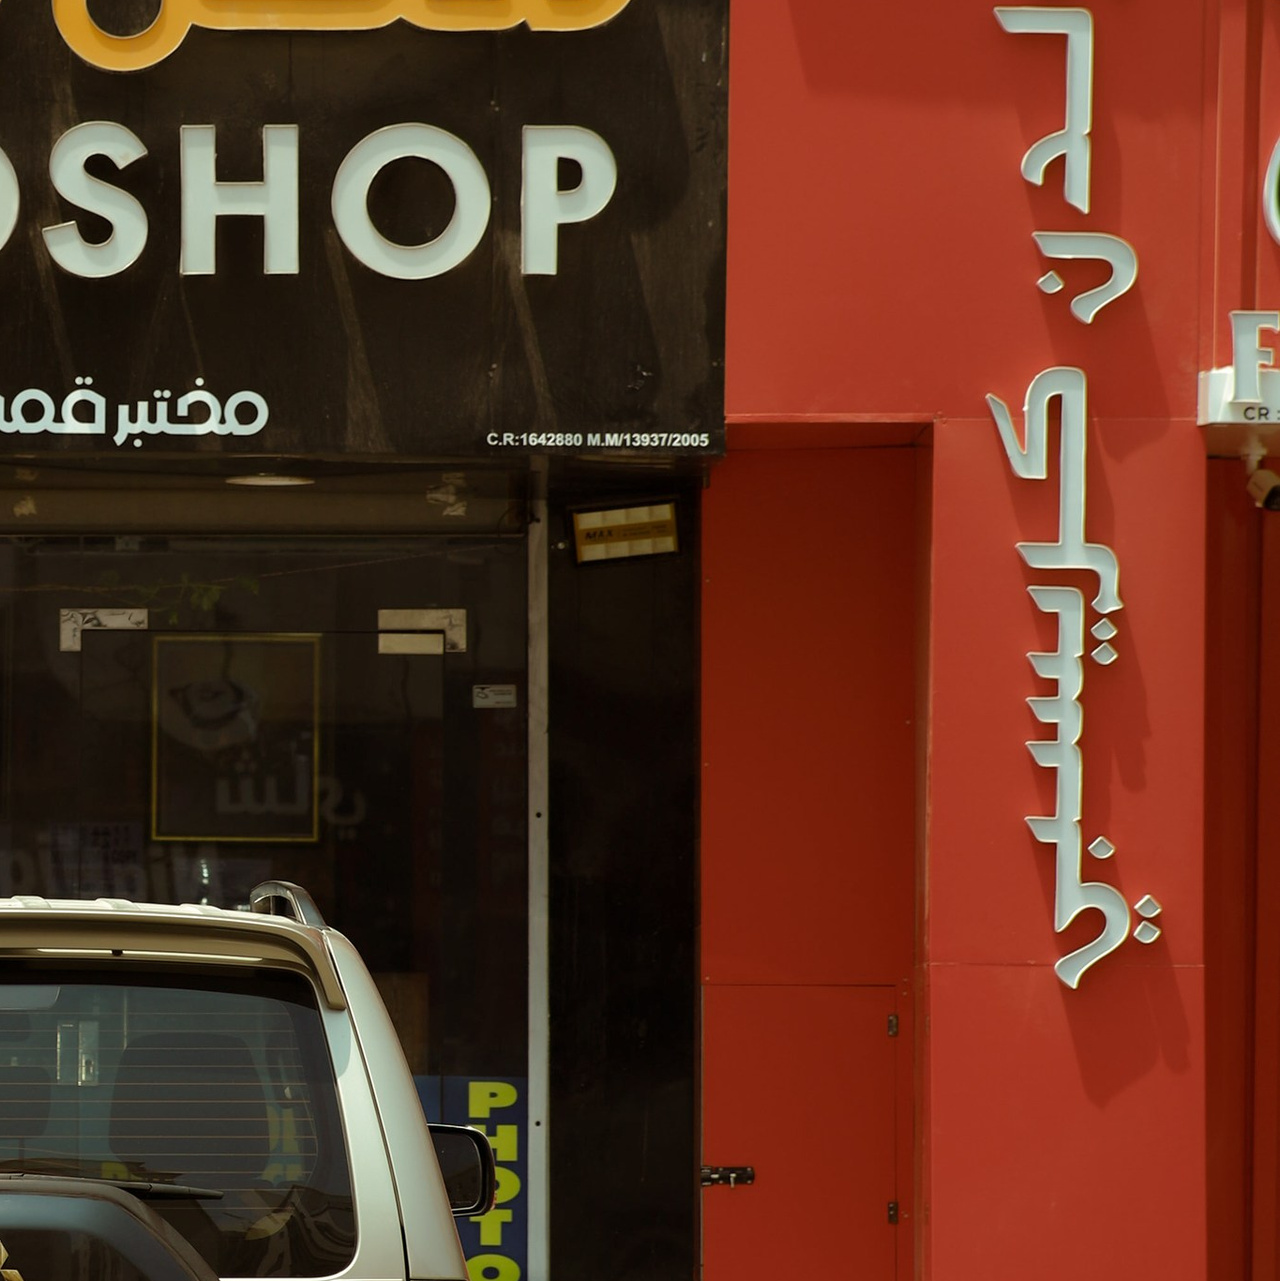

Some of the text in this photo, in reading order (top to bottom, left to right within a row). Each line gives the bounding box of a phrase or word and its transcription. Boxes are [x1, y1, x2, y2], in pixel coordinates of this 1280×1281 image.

[112, 377, 269, 448] مختبر
[486, 431, 710, 448] C.R:1642880 M.M/13937/2005
[986, 366, 1162, 990] كريسبي
